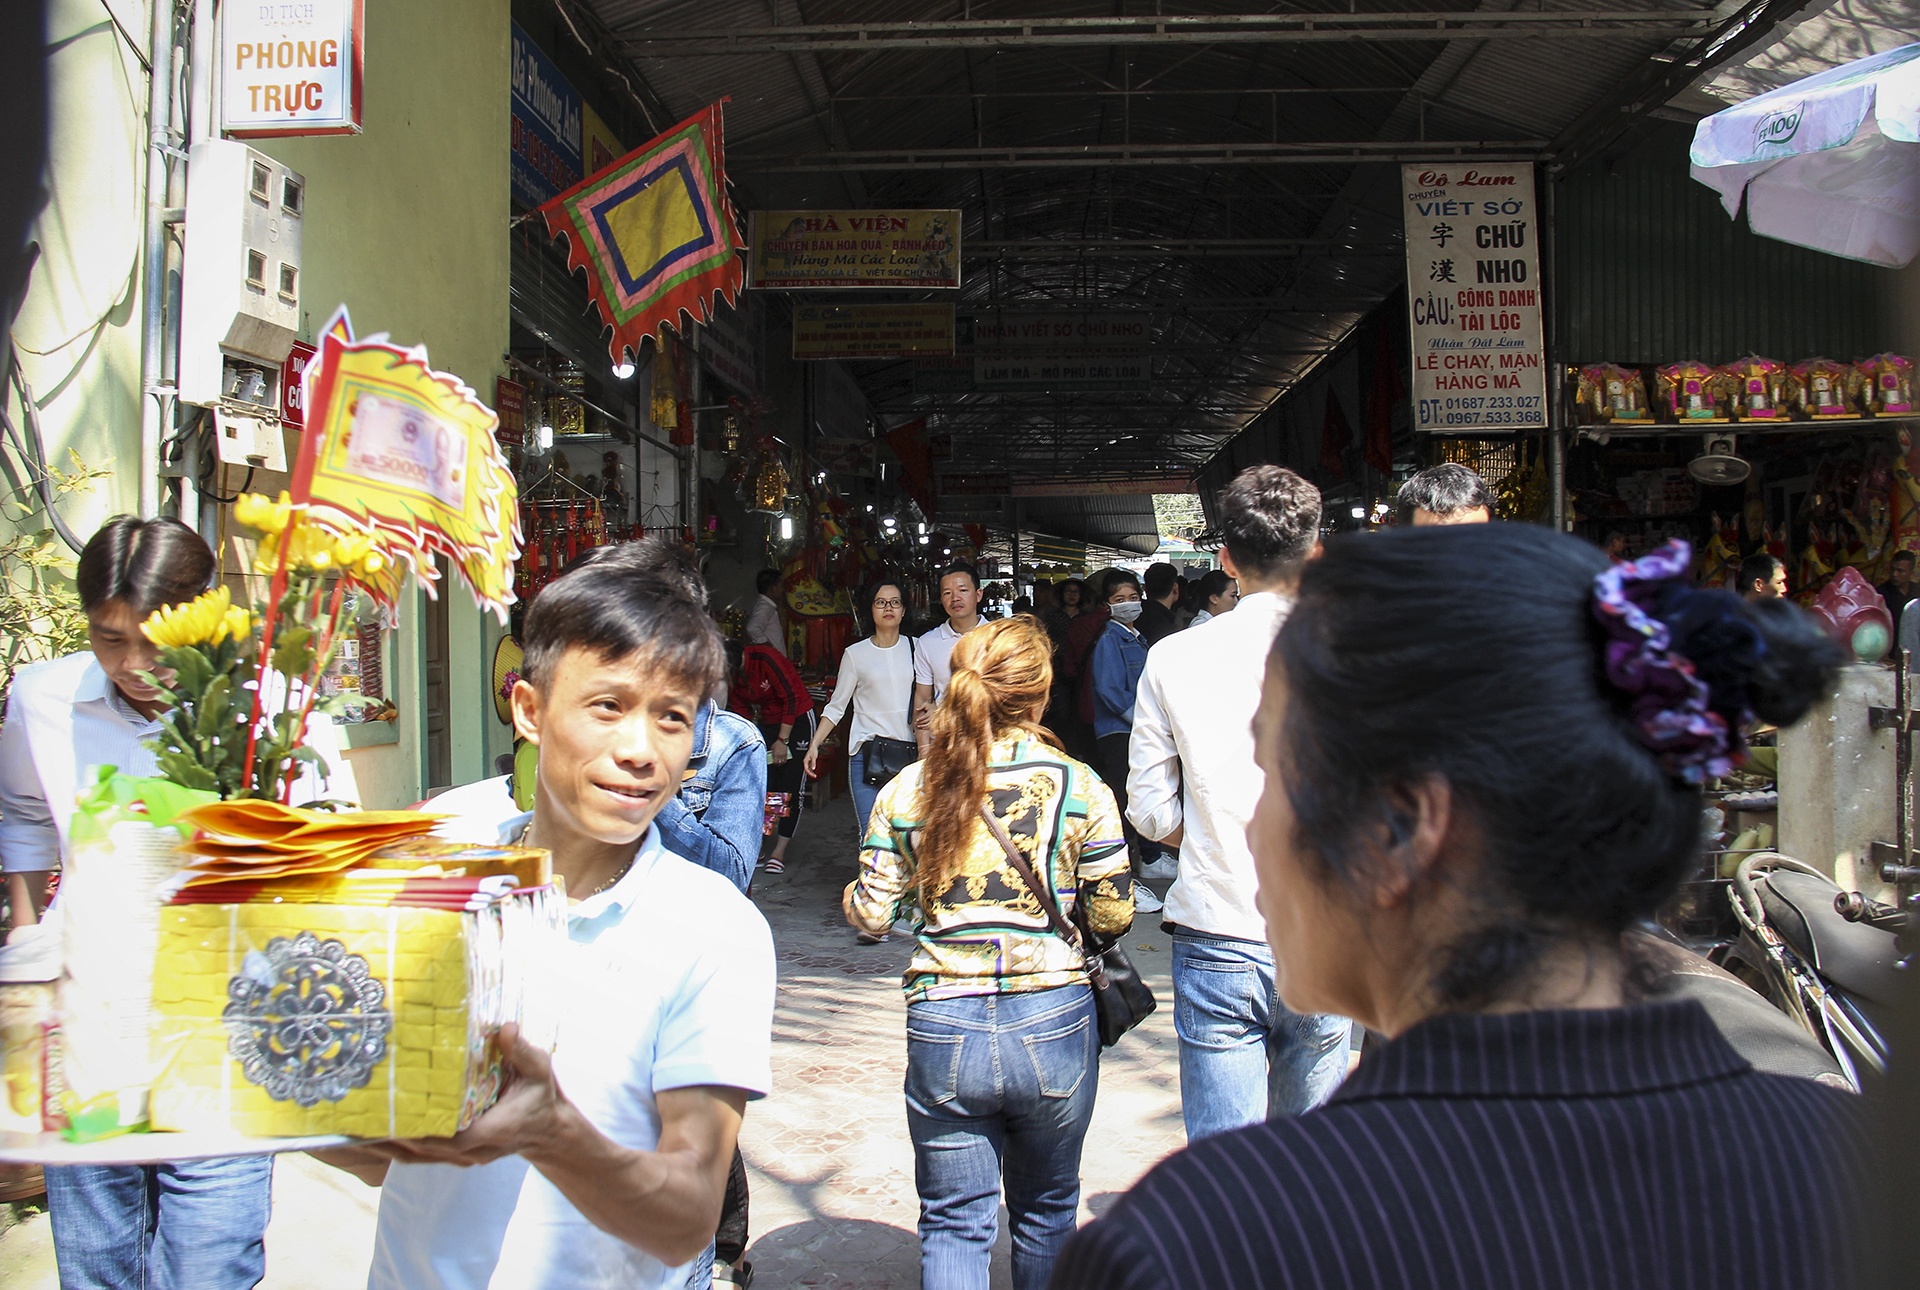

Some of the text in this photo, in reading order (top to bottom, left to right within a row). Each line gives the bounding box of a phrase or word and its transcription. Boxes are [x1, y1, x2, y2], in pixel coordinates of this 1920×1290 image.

[236, 34, 338, 71] PHÒNG
[247, 80, 323, 117] TRỰC
[563, 94, 580, 152] Anh
[1418, 170, 1517, 188] Cô Lam
[1408, 189, 1446, 201] CHUYÊN
[1415, 197, 1523, 216] VIẾT SỚ
[848, 214, 909, 236] VIỆN
[1430, 221, 1454, 249] 字
[1475, 219, 1527, 249] CHỮ
[767, 239, 808, 252] CHUYÊN
[812, 238, 833, 251] BÁN
[837, 240, 857, 251] HOA
[861, 237, 881, 251] QUẢ
[892, 238, 921, 251] BÁNH
[793, 254, 919, 267] Hàng Mã Các Loại
[1429, 258, 1457, 284] 漢
[1476, 259, 1527, 284] NHO
[1457, 287, 1536, 307] CÔNG DANH
[1414, 291, 1455, 326] CẦU:
[1022, 319, 1049, 337] VIẾT
[1054, 319, 1072, 337] SỚ
[1077, 320, 1107, 336] CHỮ
[1112, 322, 1143, 336] NHO
[1459, 310, 1521, 334] TÀI LỘC
[1417, 351, 1538, 372] LỄ CHAY, MẶN
[1435, 371, 1522, 390] HÀNG MÃ
[1419, 398, 1443, 425] ĐT:
[1446, 396, 1541, 409] 01687.233.027
[1446, 411, 1542, 425] 0967.533.368
